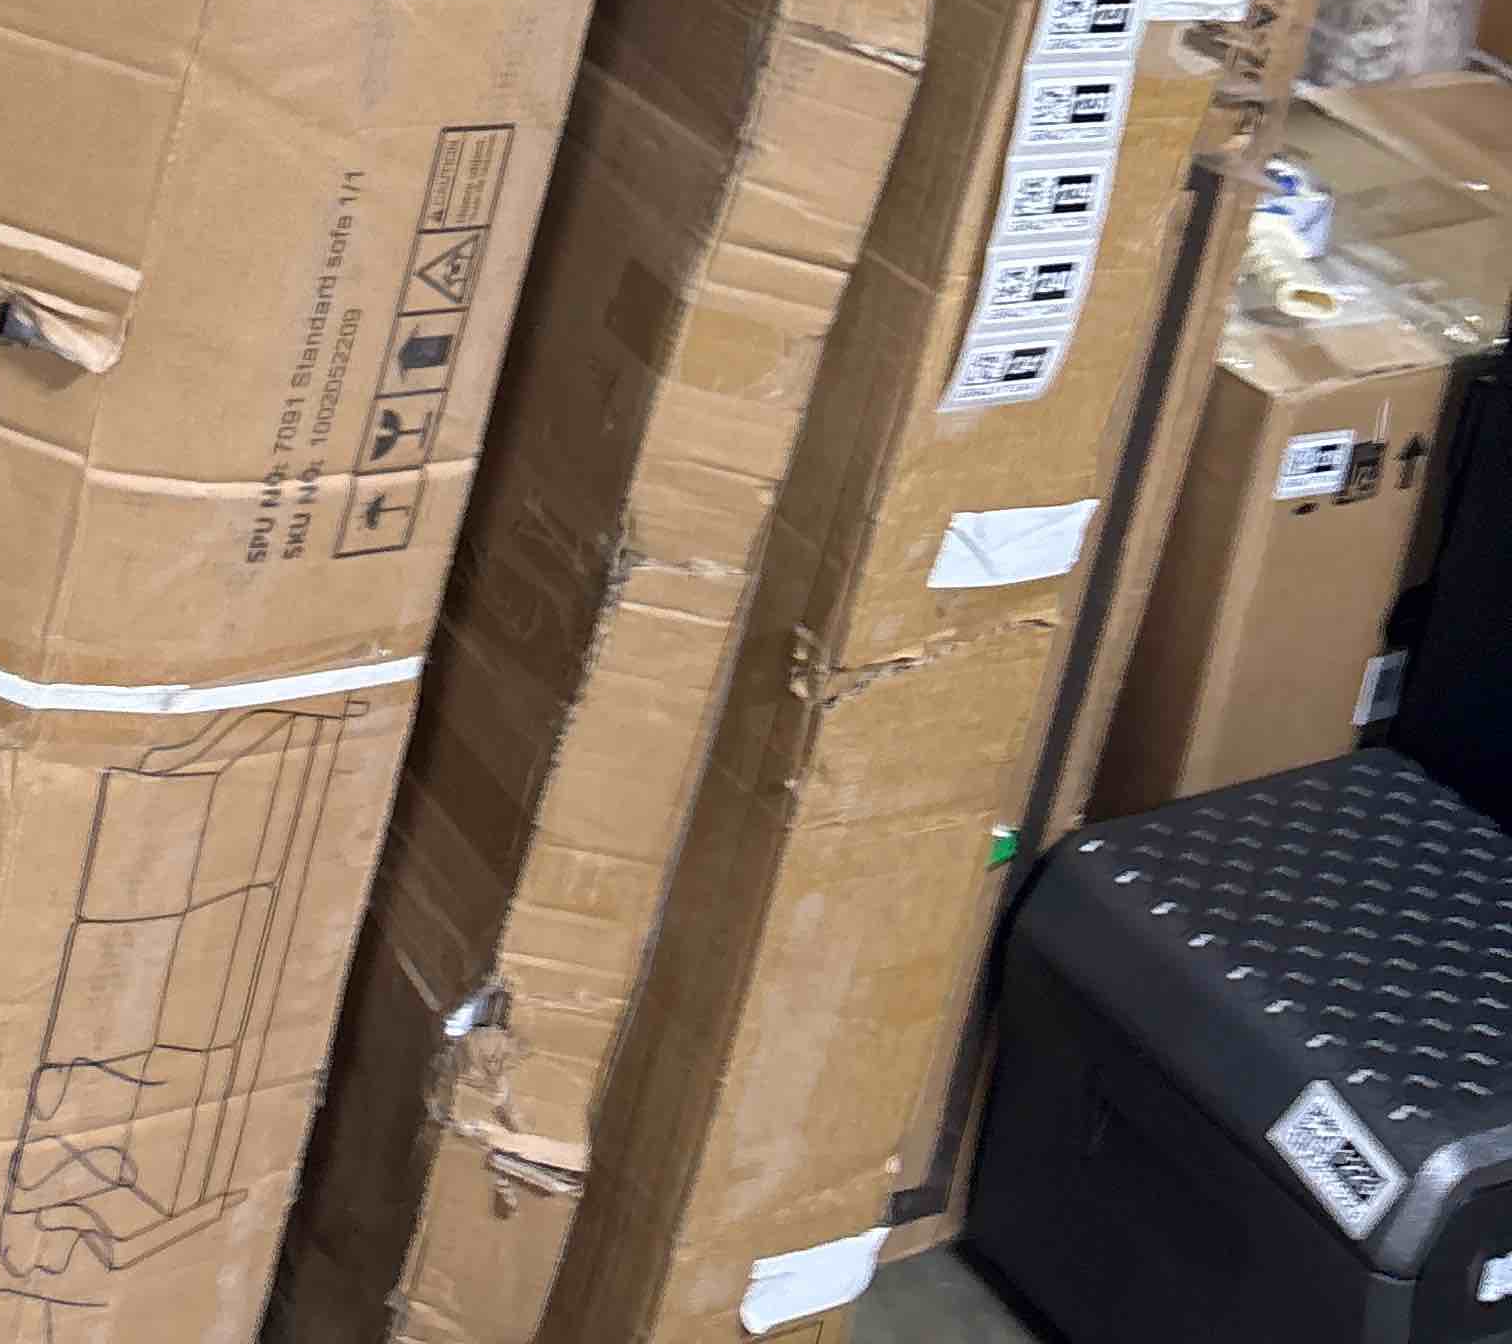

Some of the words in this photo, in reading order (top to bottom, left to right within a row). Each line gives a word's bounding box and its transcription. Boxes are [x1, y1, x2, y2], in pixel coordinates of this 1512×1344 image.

[339, 170, 365, 209] 1/1
[327, 215, 353, 267] sofa
[292, 274, 337, 388] Standard
[282, 511, 311, 560] SKU
